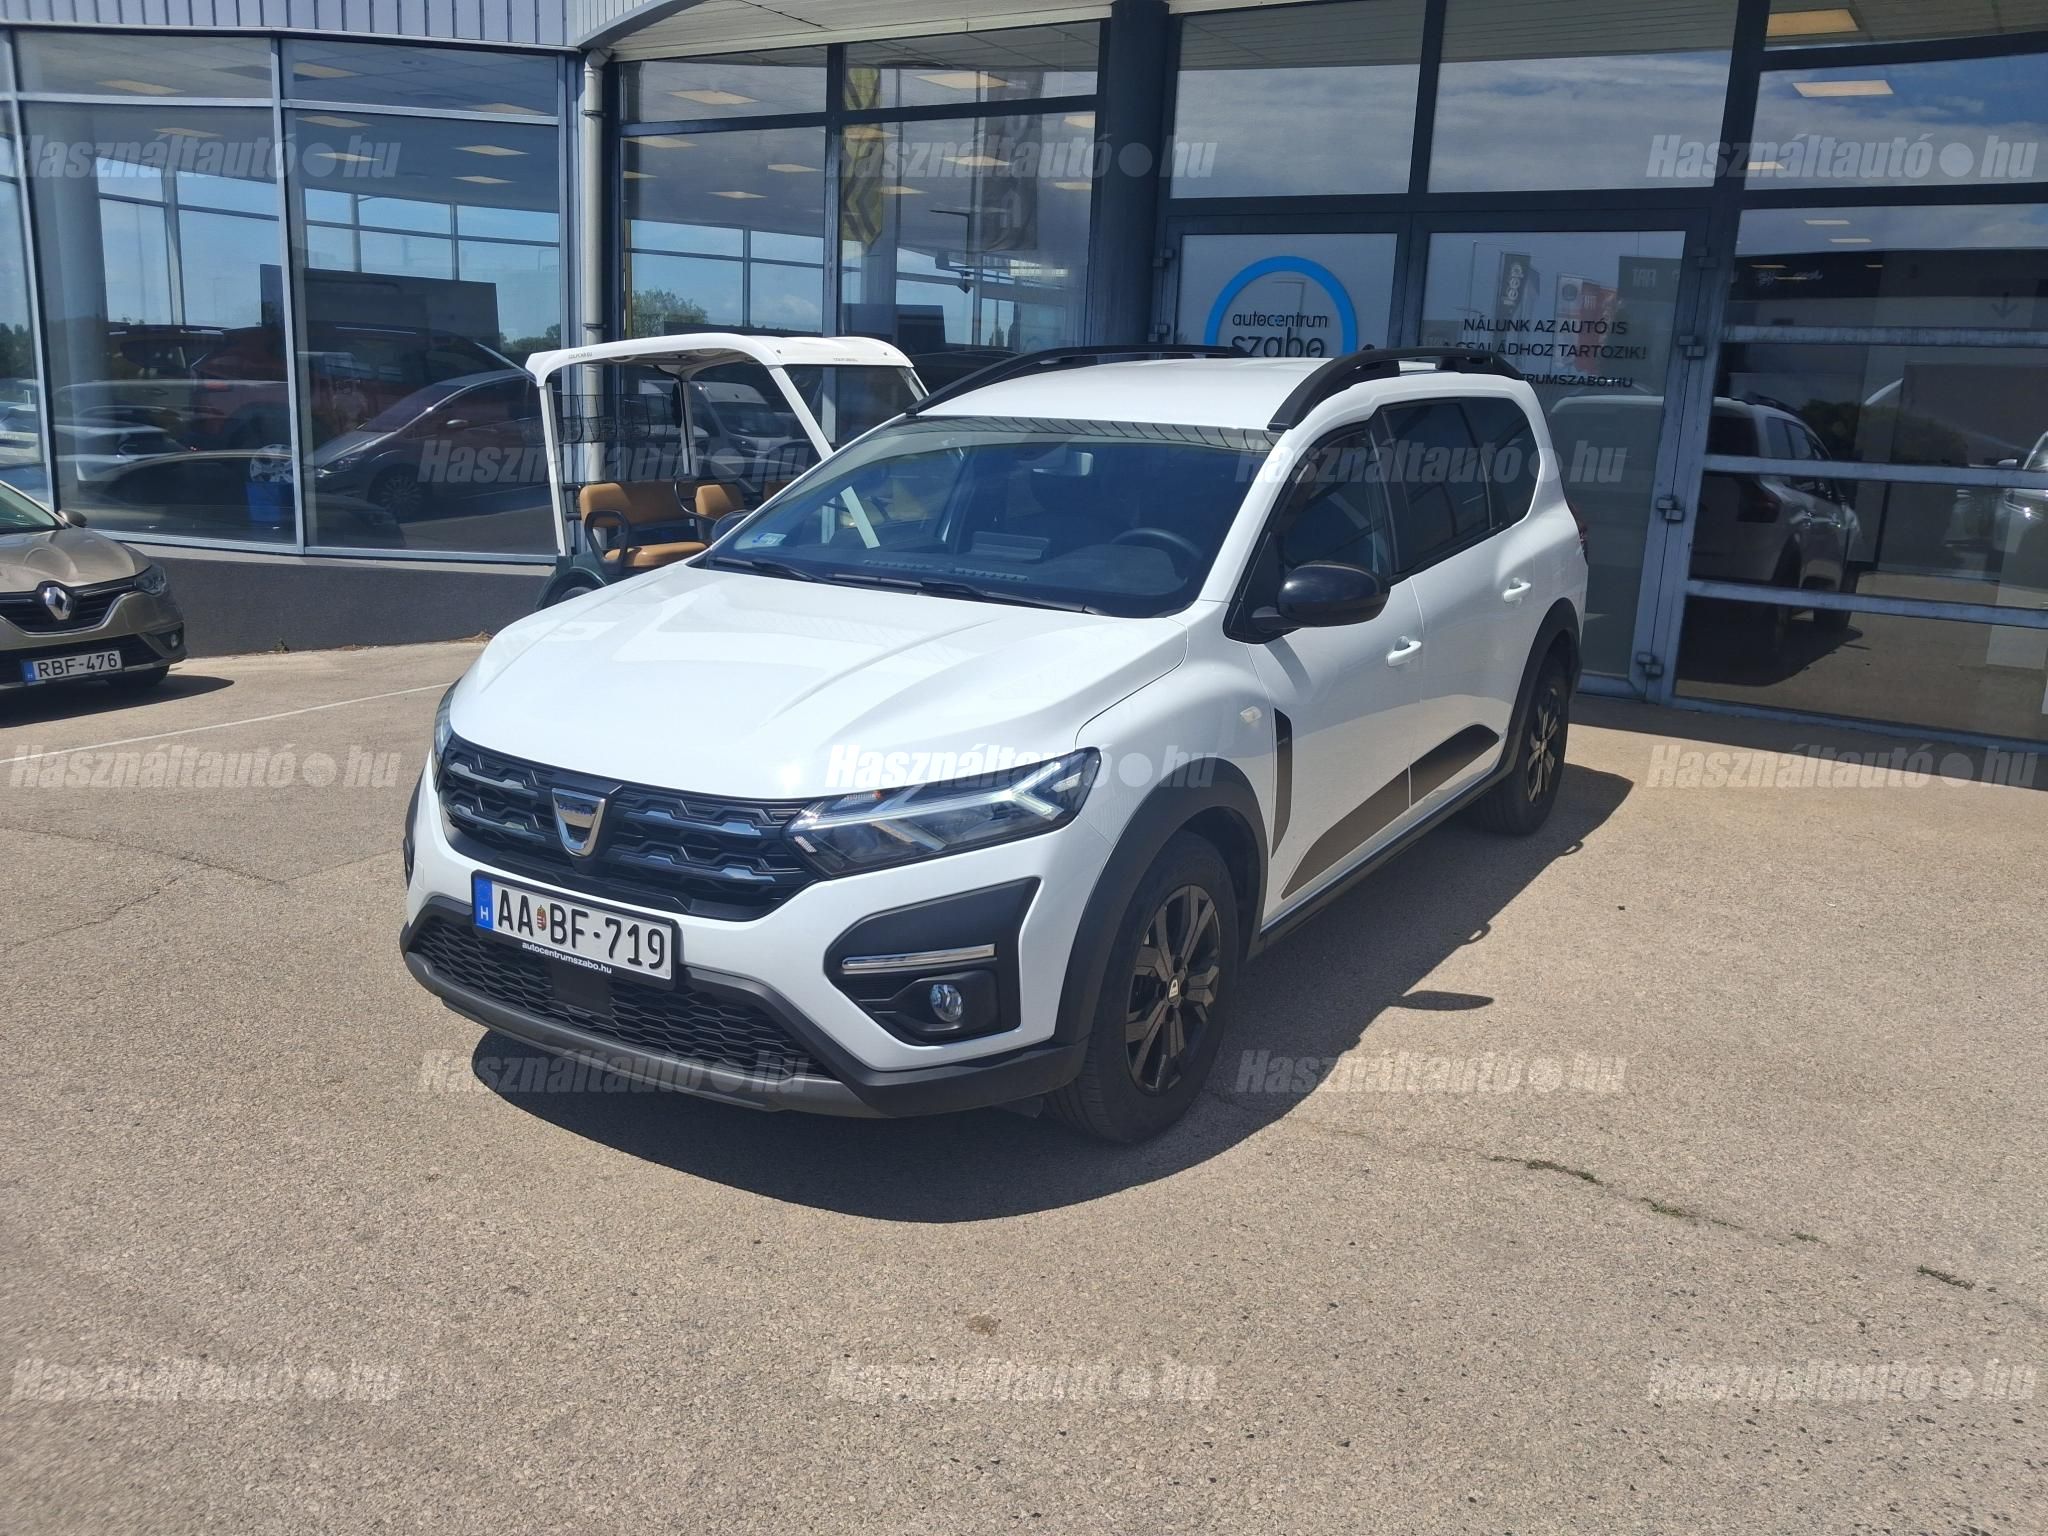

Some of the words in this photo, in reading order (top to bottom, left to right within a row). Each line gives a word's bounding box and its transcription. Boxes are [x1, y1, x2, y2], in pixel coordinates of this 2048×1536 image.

[1232, 311, 1328, 328] autocentrum
[1463, 314, 1530, 332] NÁLUNK
[1534, 319, 1556, 333] AZ
[1559, 315, 1607, 335] AUTÓ
[1611, 321, 1627, 335] IS
[1558, 344, 1648, 360] TARTOZIK!
[37, 653, 118, 677] RBF-476
[522, 941, 612, 974] autocentrumszabo.hu
